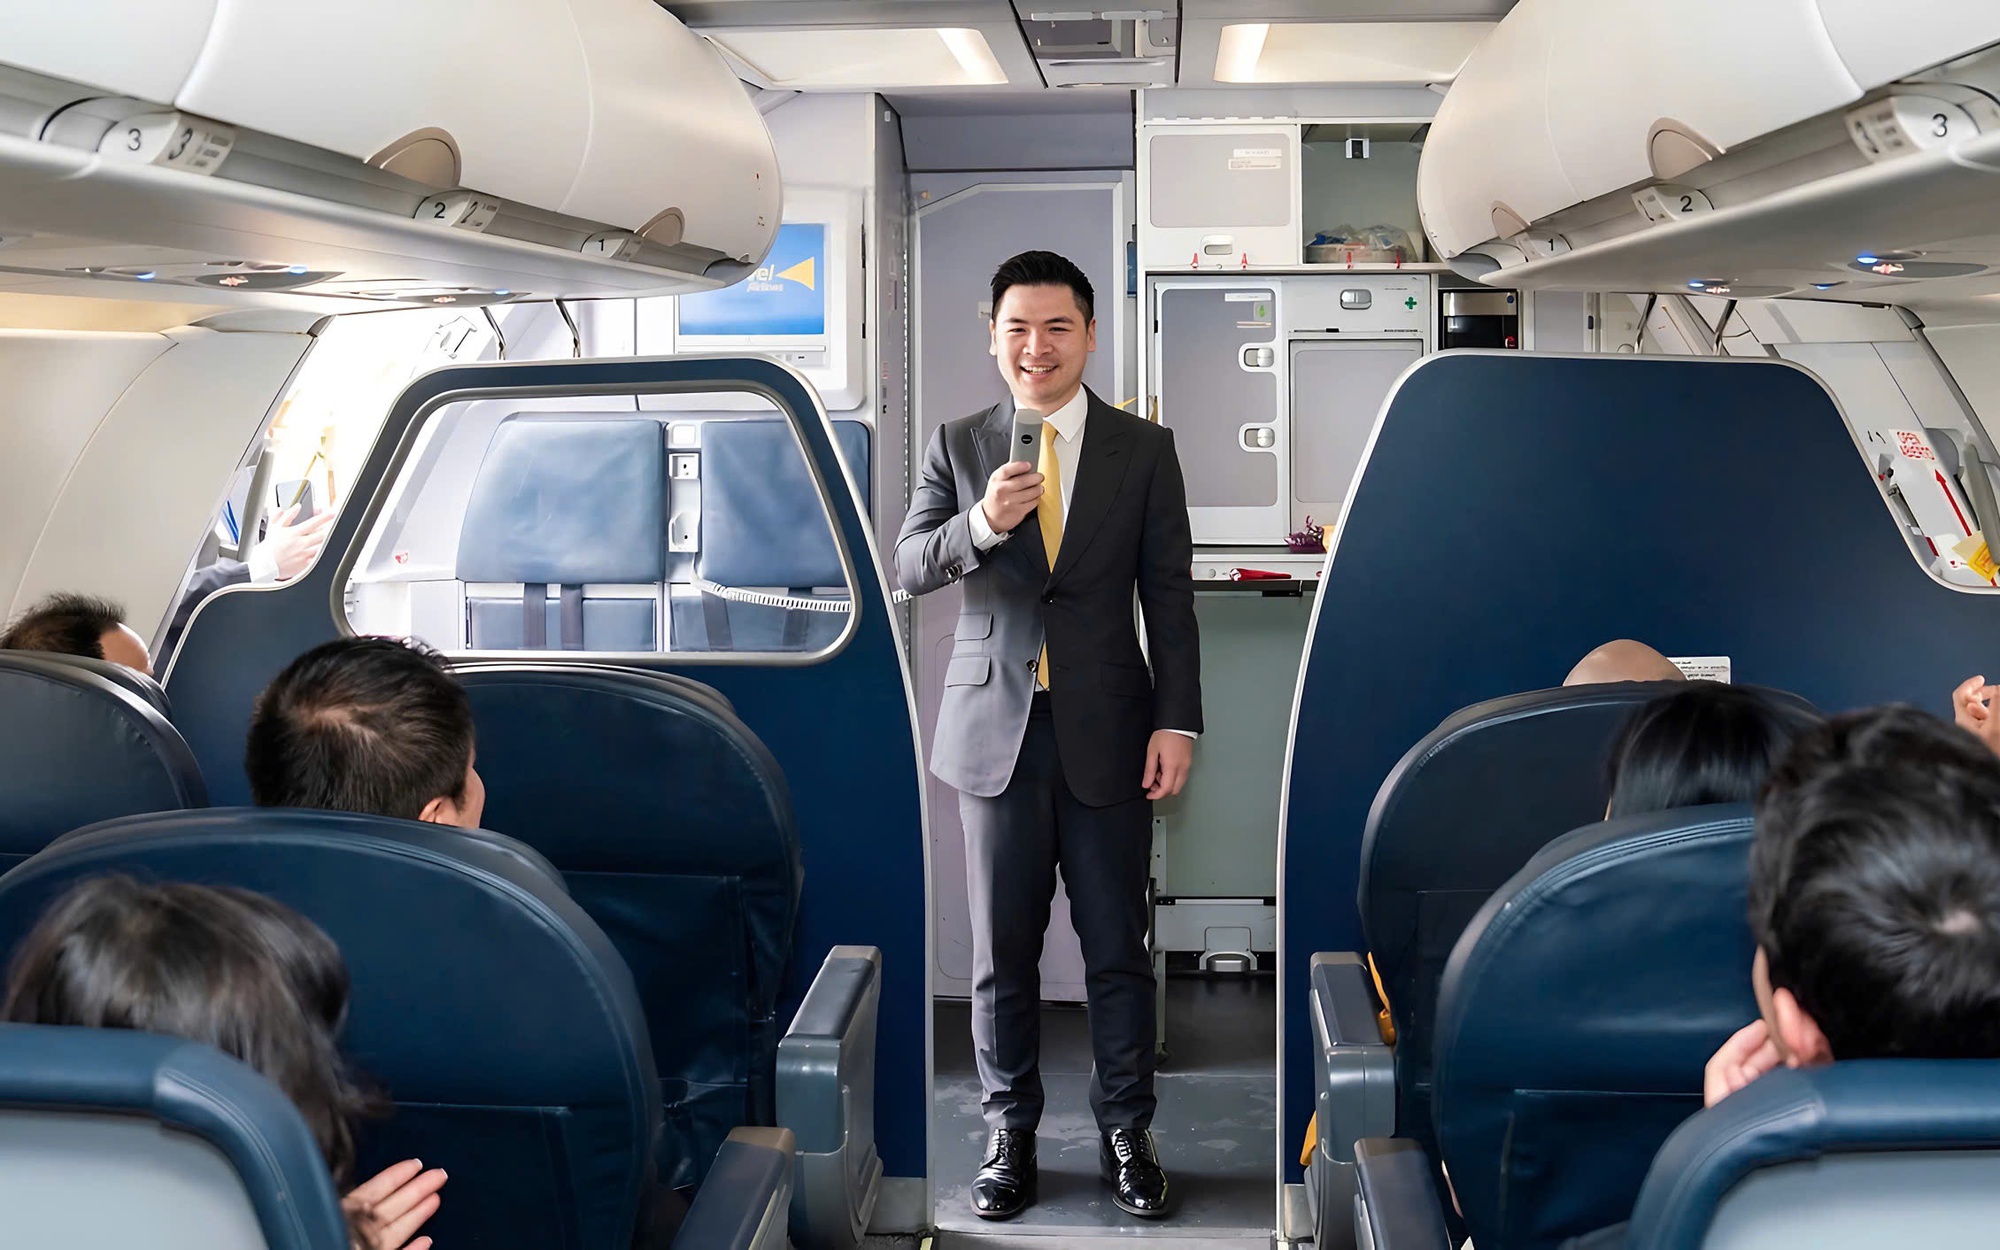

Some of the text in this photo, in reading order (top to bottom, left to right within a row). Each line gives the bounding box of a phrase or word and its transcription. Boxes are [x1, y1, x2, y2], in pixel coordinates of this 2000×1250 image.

[1932, 113, 1948, 138] 3
[128, 128, 141, 151] 3
[433, 201, 446, 219] 2
[1679, 195, 1693, 212] 2
[598, 238, 606, 252] 1
[1548, 238, 1555, 252] 1
